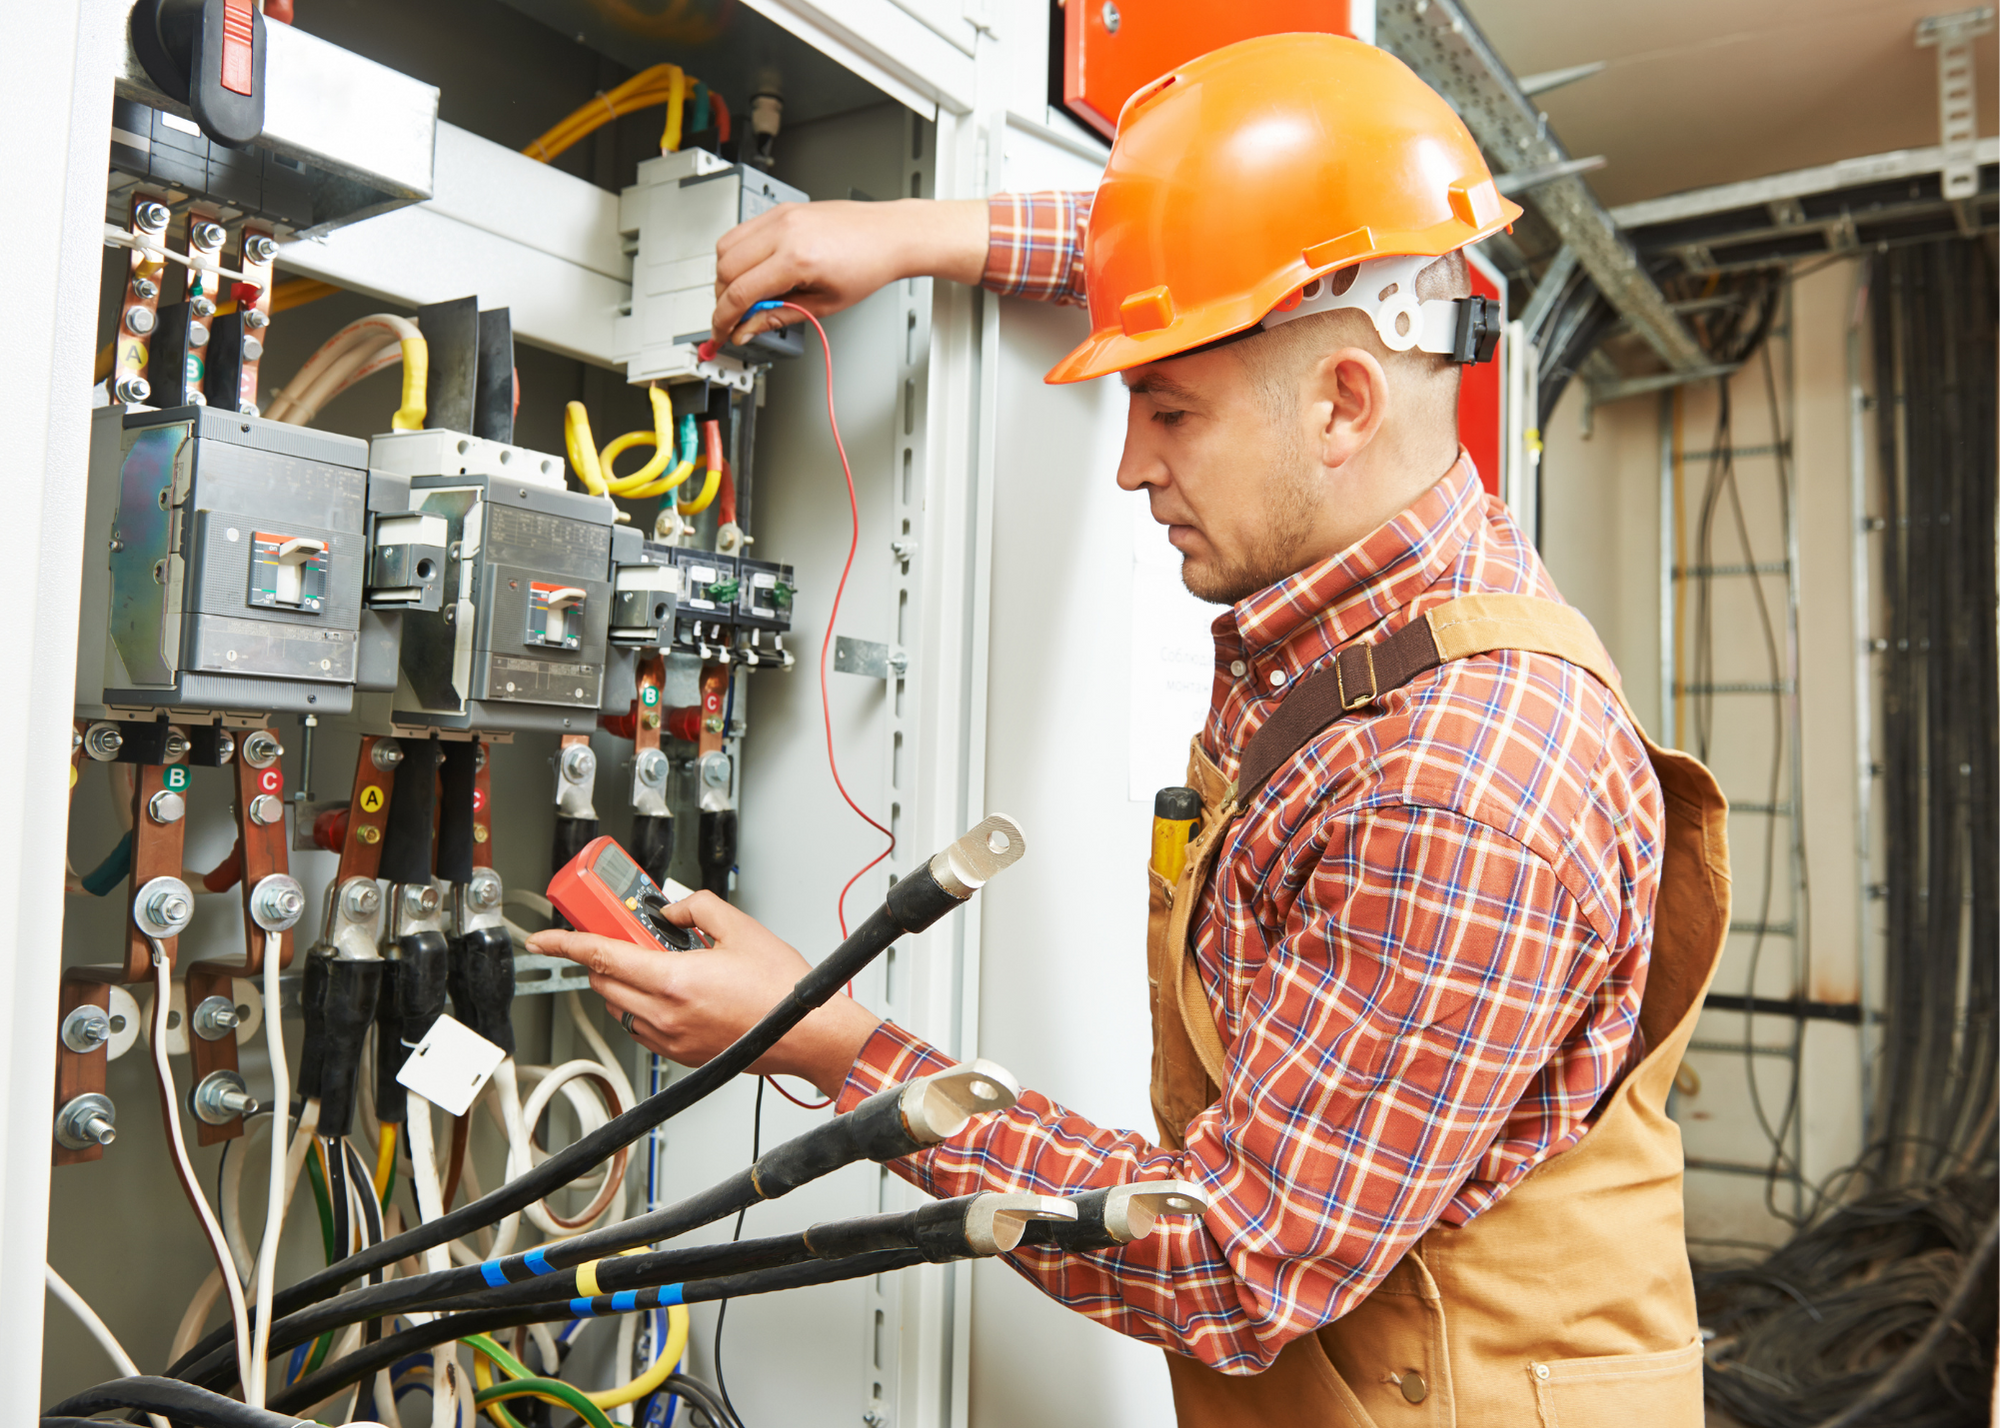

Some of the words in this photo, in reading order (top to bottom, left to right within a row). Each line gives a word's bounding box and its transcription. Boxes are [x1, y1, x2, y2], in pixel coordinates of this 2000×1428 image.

[125, 344, 142, 364] A
[187, 358, 199, 379] B
[645, 688, 656, 704] B
[707, 695, 717, 710] C
[169, 768, 185, 787] B
[262, 771, 277, 790] C
[366, 790, 378, 806] A
